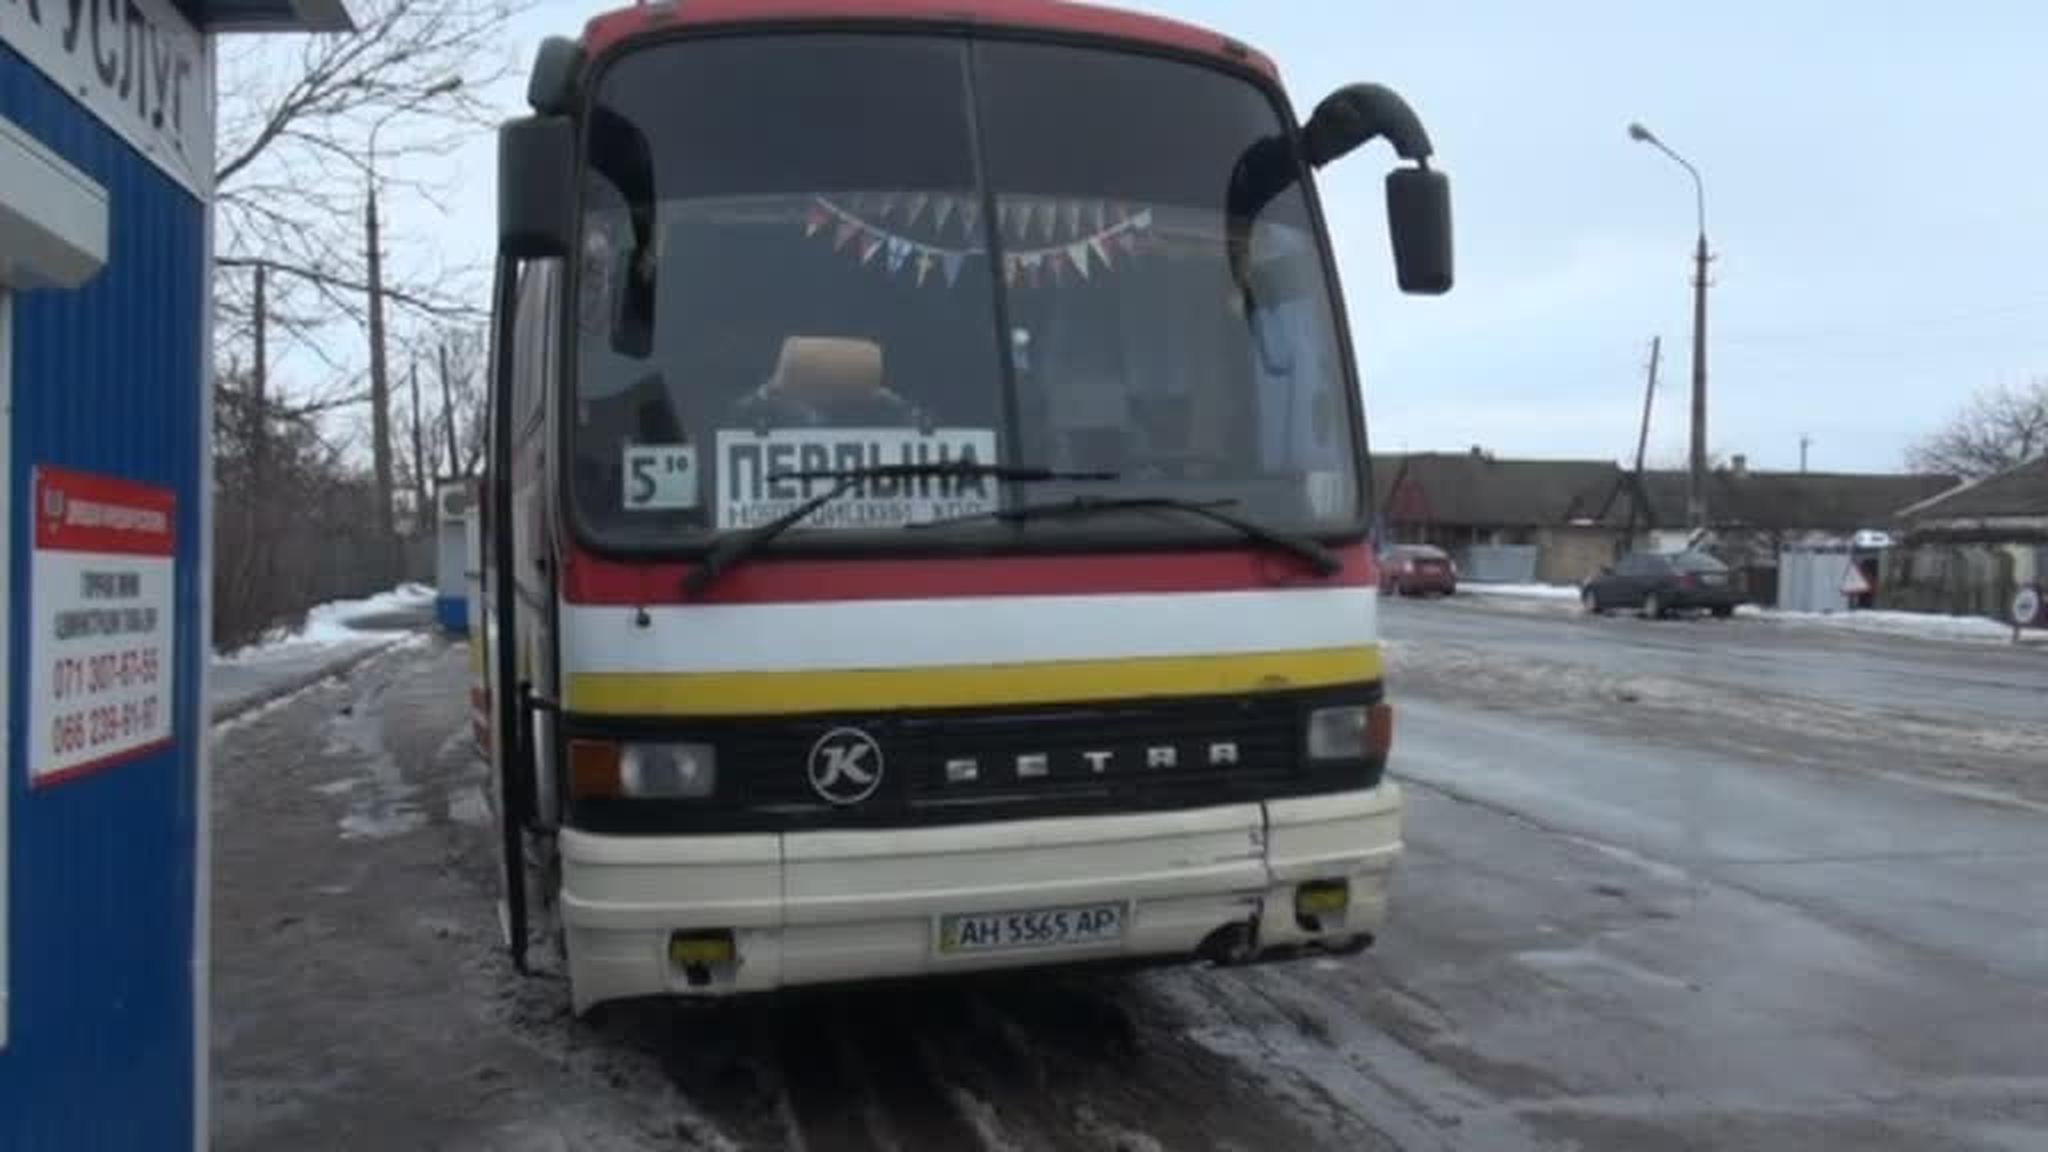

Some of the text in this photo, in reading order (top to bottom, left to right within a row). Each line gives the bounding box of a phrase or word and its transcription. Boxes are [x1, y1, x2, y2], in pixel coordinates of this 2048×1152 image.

[632, 457, 656, 503] 5
[946, 742, 1238, 781] SETRA
[1007, 912, 1069, 940] 5565
